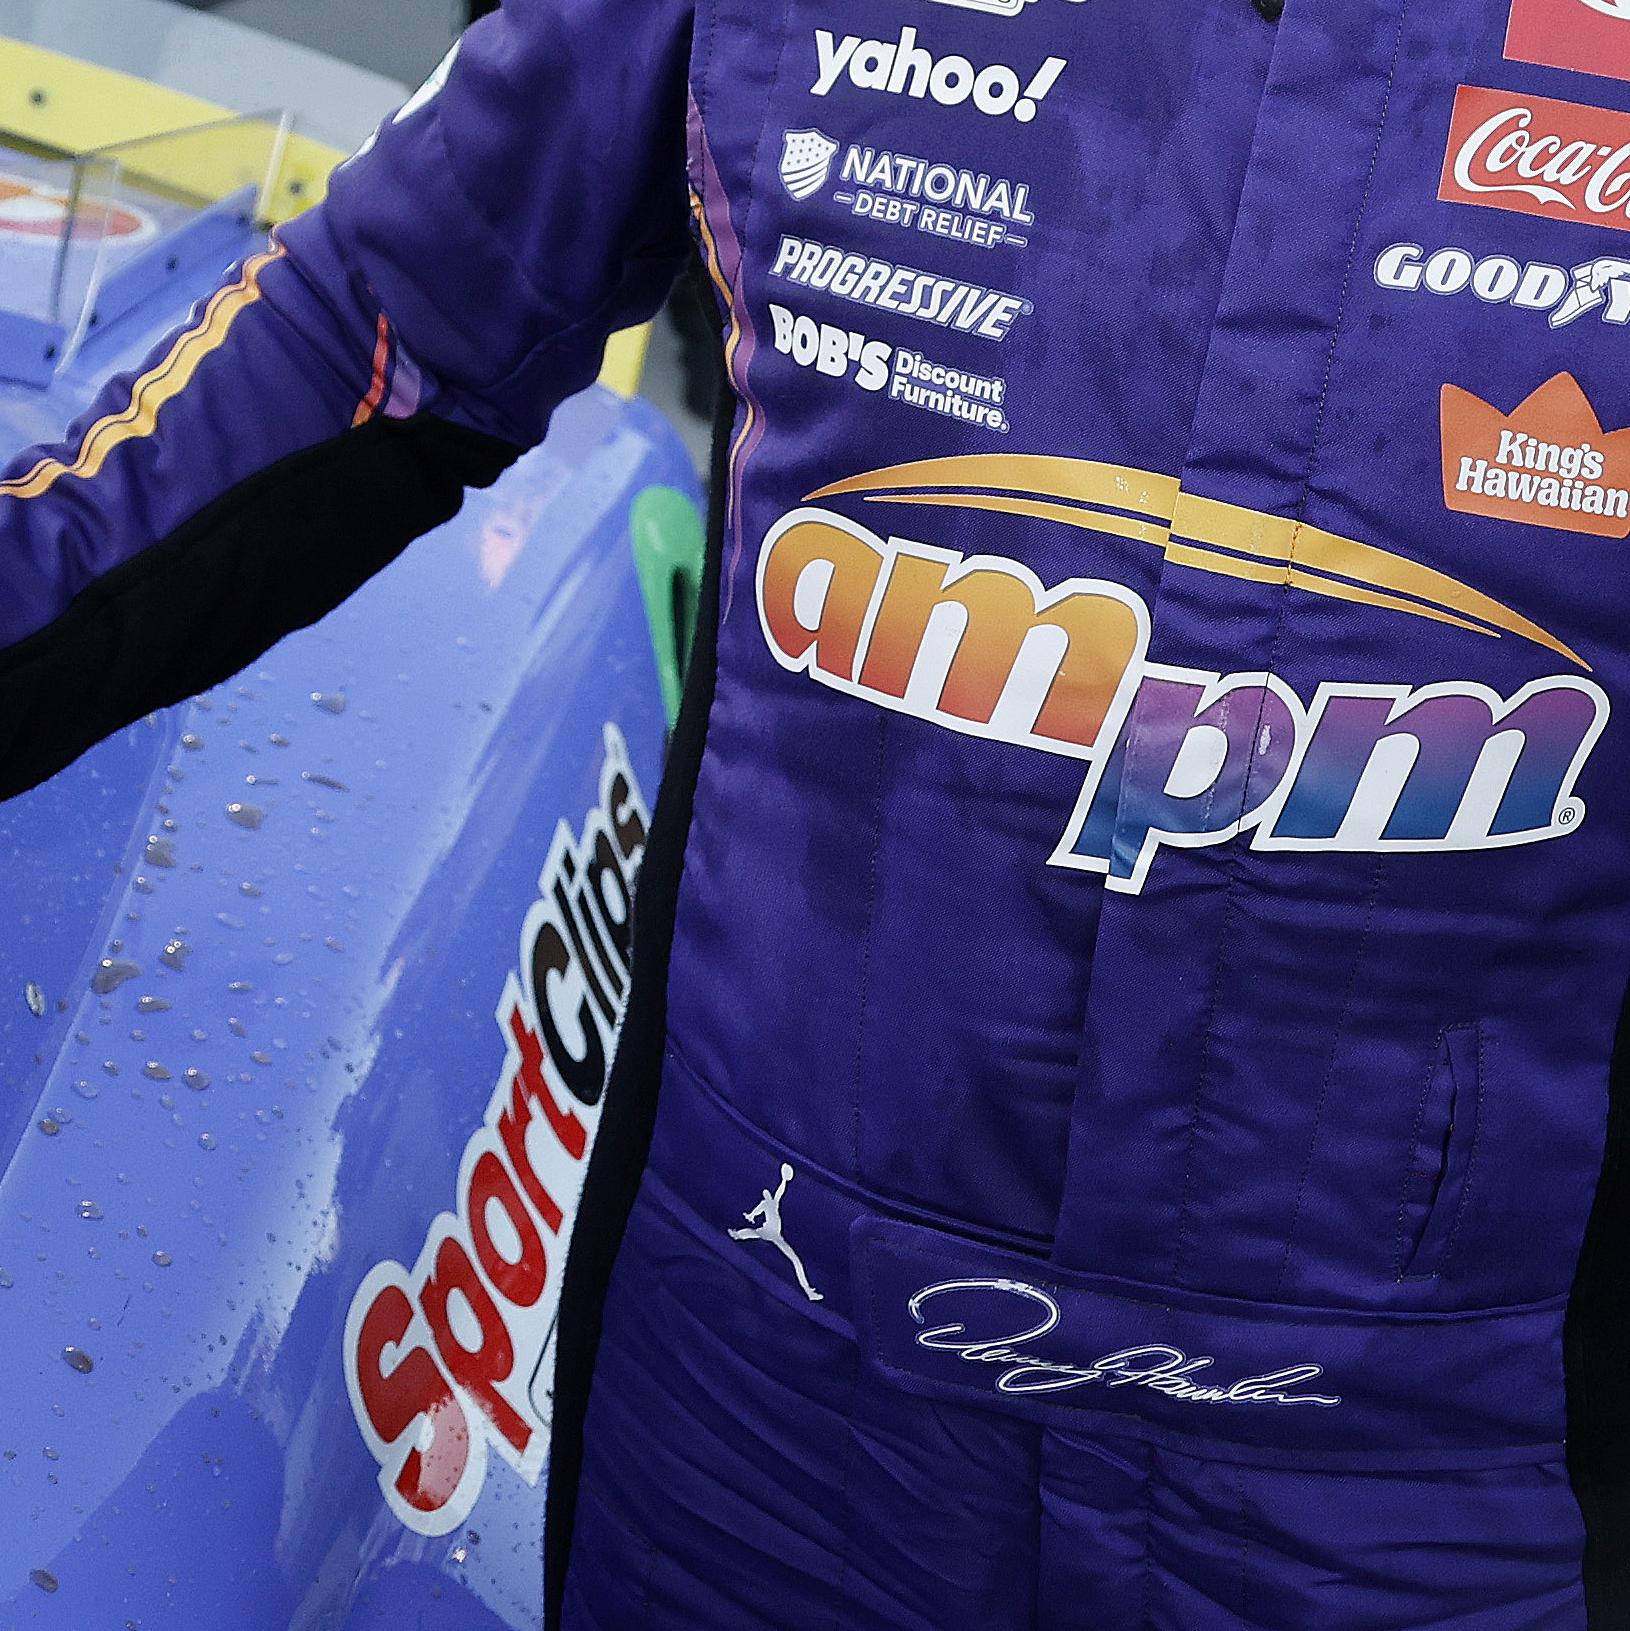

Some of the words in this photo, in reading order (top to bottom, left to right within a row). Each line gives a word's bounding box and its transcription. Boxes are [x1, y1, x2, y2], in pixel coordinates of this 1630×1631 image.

[810, 26, 1068, 123] yahoo!
[841, 146, 1035, 225] NATIONAL
[853, 192, 919, 225] DEBT
[921, 208, 1006, 248] RELIEF
[770, 236, 1024, 340] PROGRESSIVE
[769, 303, 893, 391] BOB'S
[895, 350, 1004, 403] Discount
[1454, 456, 1630, 519] Hawaiian
[1495, 429, 1606, 480] King's
[755, 507, 1609, 895] ampm
